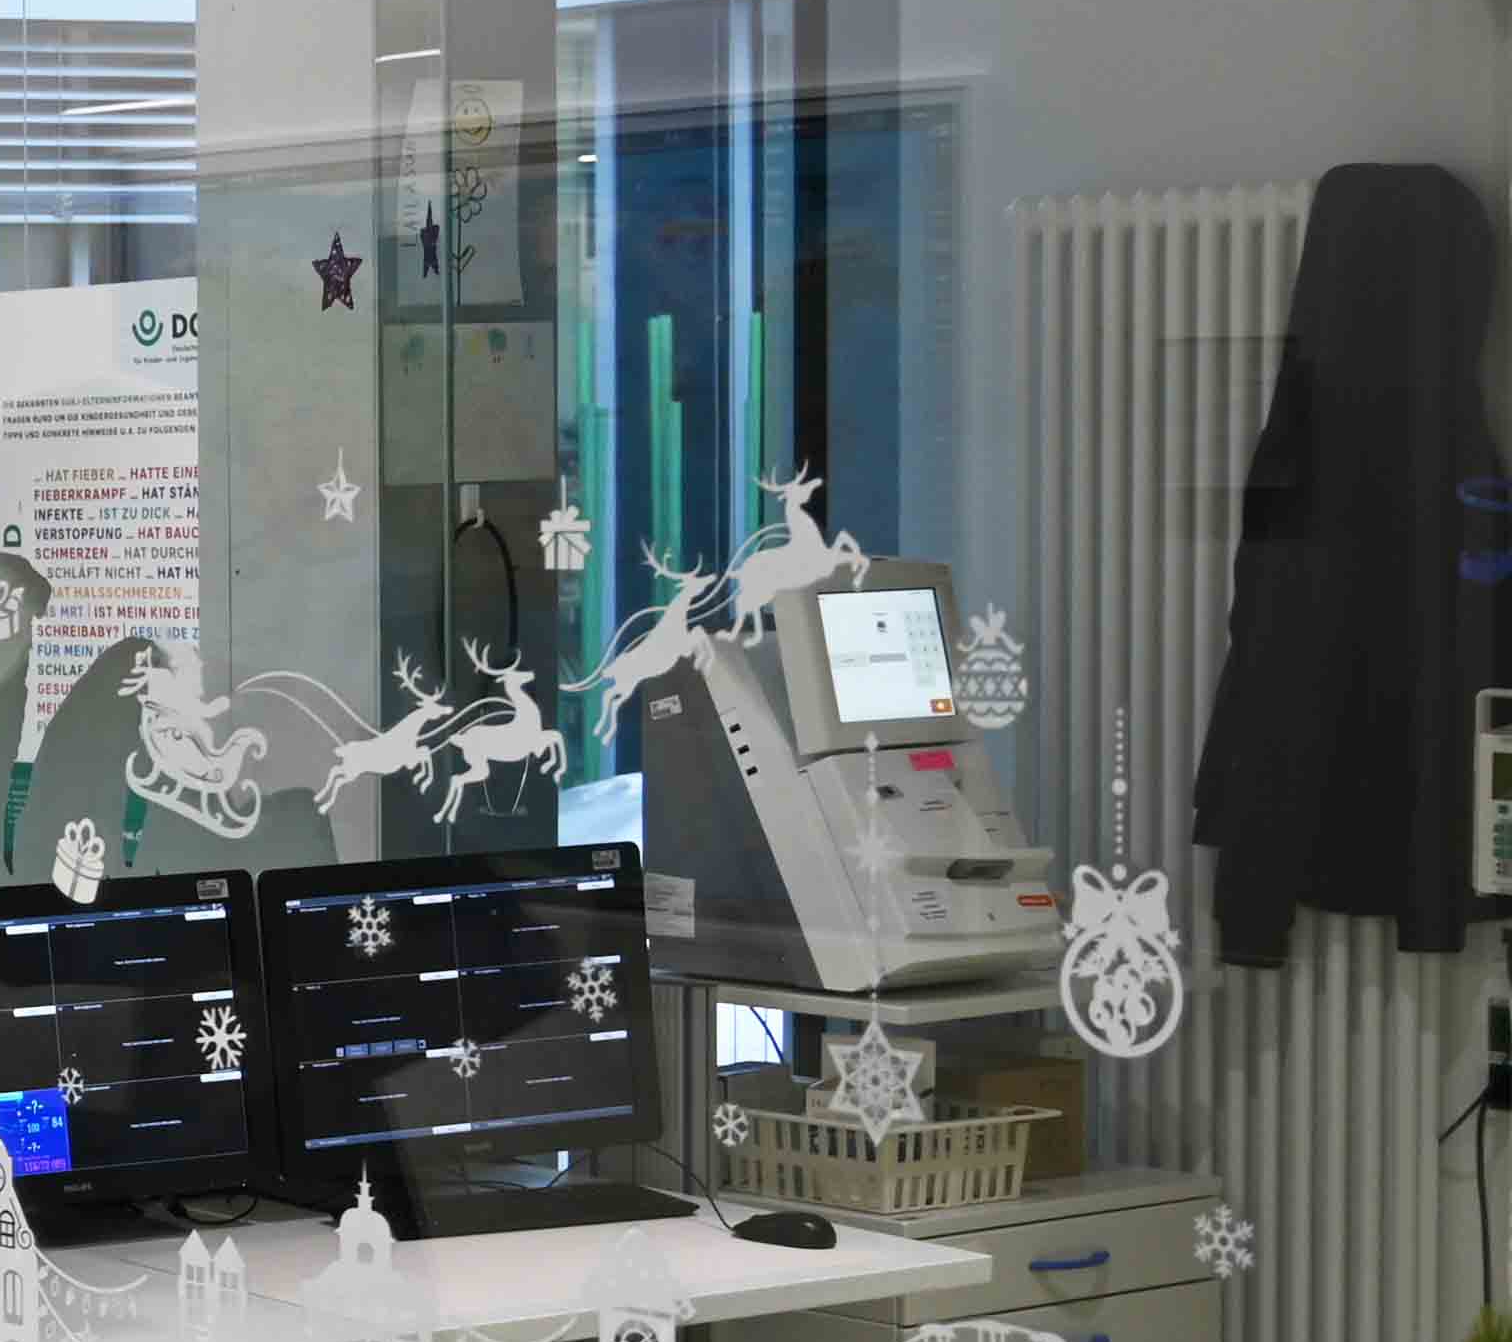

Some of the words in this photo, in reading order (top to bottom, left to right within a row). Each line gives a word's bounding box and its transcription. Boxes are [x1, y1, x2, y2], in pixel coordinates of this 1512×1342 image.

[46, 469, 68, 482] HAT
[72, 468, 114, 482] FIEBER
[130, 467, 169, 479] HATTE
[34, 487, 127, 501] FIEBERKRAMPF
[142, 487, 165, 499] HAT
[34, 508, 84, 521] INFEKTE
[99, 508, 118, 520] IST
[122, 507, 138, 520] ZU
[141, 507, 171, 519] DICK
[35, 527, 122, 540] VERSTOPFUNG
[138, 527, 162, 539] HAT
[35, 547, 108, 560] SCHMERZEN
[124, 547, 148, 559] HAT
[105, 566, 141, 579] NICHT
[157, 567, 181, 579] HAT
[74, 587, 184, 599] HALSSCHMERZEN
[61, 605, 83, 618] MRT
[94, 607, 112, 619] IST
[117, 607, 147, 619] MEIN
[151, 607, 180, 619] KIND
[37, 625, 119, 638] SCHREIBABY?
[37, 642, 60, 657] FÜR
[64, 644, 93, 657] MEIN
